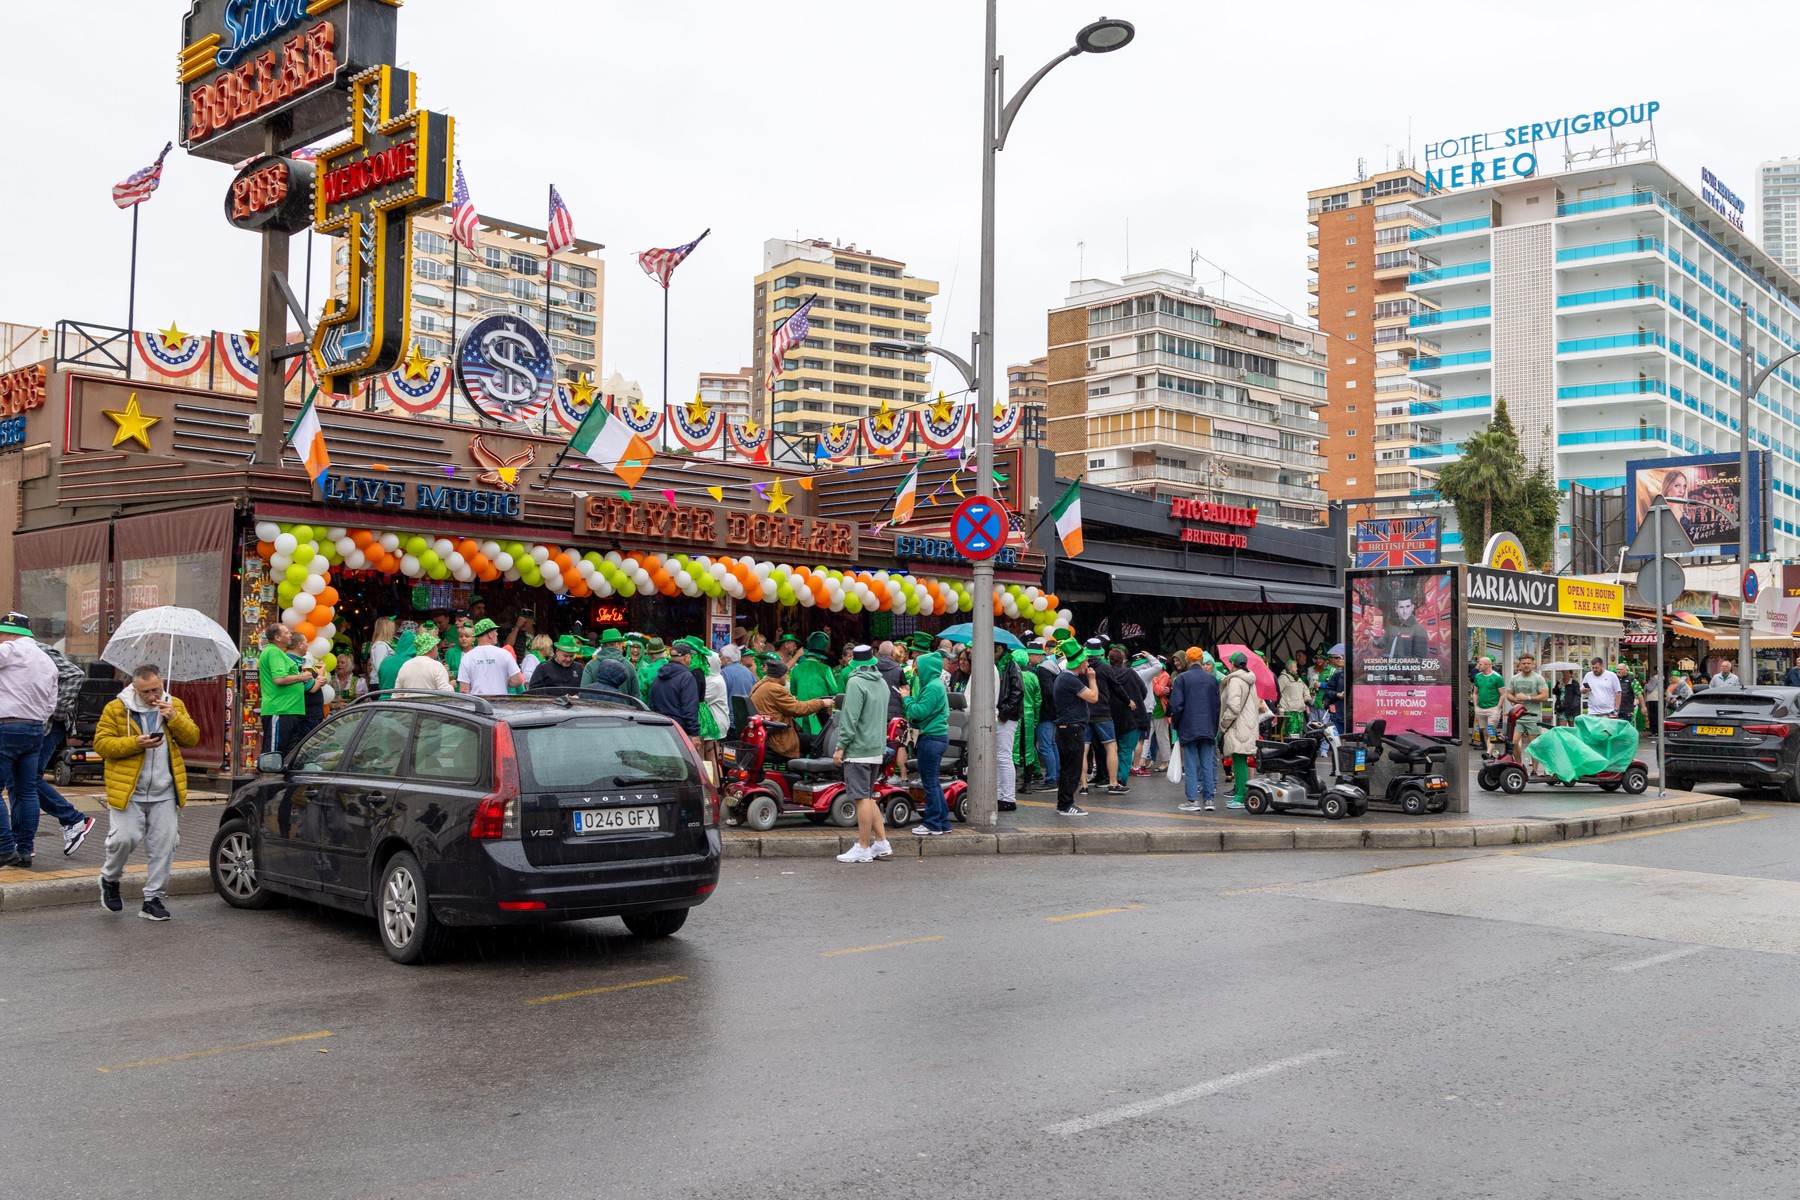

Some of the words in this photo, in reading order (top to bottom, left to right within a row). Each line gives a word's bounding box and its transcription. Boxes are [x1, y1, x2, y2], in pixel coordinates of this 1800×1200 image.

[189, 20, 338, 142] DOLLAR
[1425, 132, 1494, 161] HOTEL
[1504, 101, 1660, 147] SERVIGROUP
[323, 139, 416, 205] WELCOME
[1425, 152, 1537, 193] NEREO
[232, 163, 288, 220] PUB
[324, 474, 405, 507] LIVE
[417, 484, 521, 517] MUSIC
[1171, 497, 1259, 528] PICCADILLY
[586, 496, 719, 544] SILVER
[726, 510, 854, 556] DOLLAR
[1366, 520, 1427, 536] PICCADILLY
[898, 536, 966, 561] SPORT
[1181, 528, 1227, 546] BRITISH
[1229, 534, 1248, 549] PUB
[1368, 542, 1405, 551] BRITISH
[1406, 541, 1426, 550] PUB
[1495, 545, 1511, 566] SNACK
[1512, 549, 1522, 568] BAR
[1567, 585, 1585, 596] OPEN
[1586, 587, 1594, 598] 24
[1594, 588, 1616, 600] HOURS
[1573, 600, 1591, 611] TAKE
[1592, 602, 1610, 613] AWAY
[1363, 656, 1388, 664] VERSIÓN
[1421, 660, 1440, 669] 50%
[1375, 698, 1394, 707] 11.11
[1395, 699, 1427, 708] PROMO
[583, 794, 659, 803] VOLVO
[585, 811, 624, 828] 0246
[530, 829, 554, 837] V50
